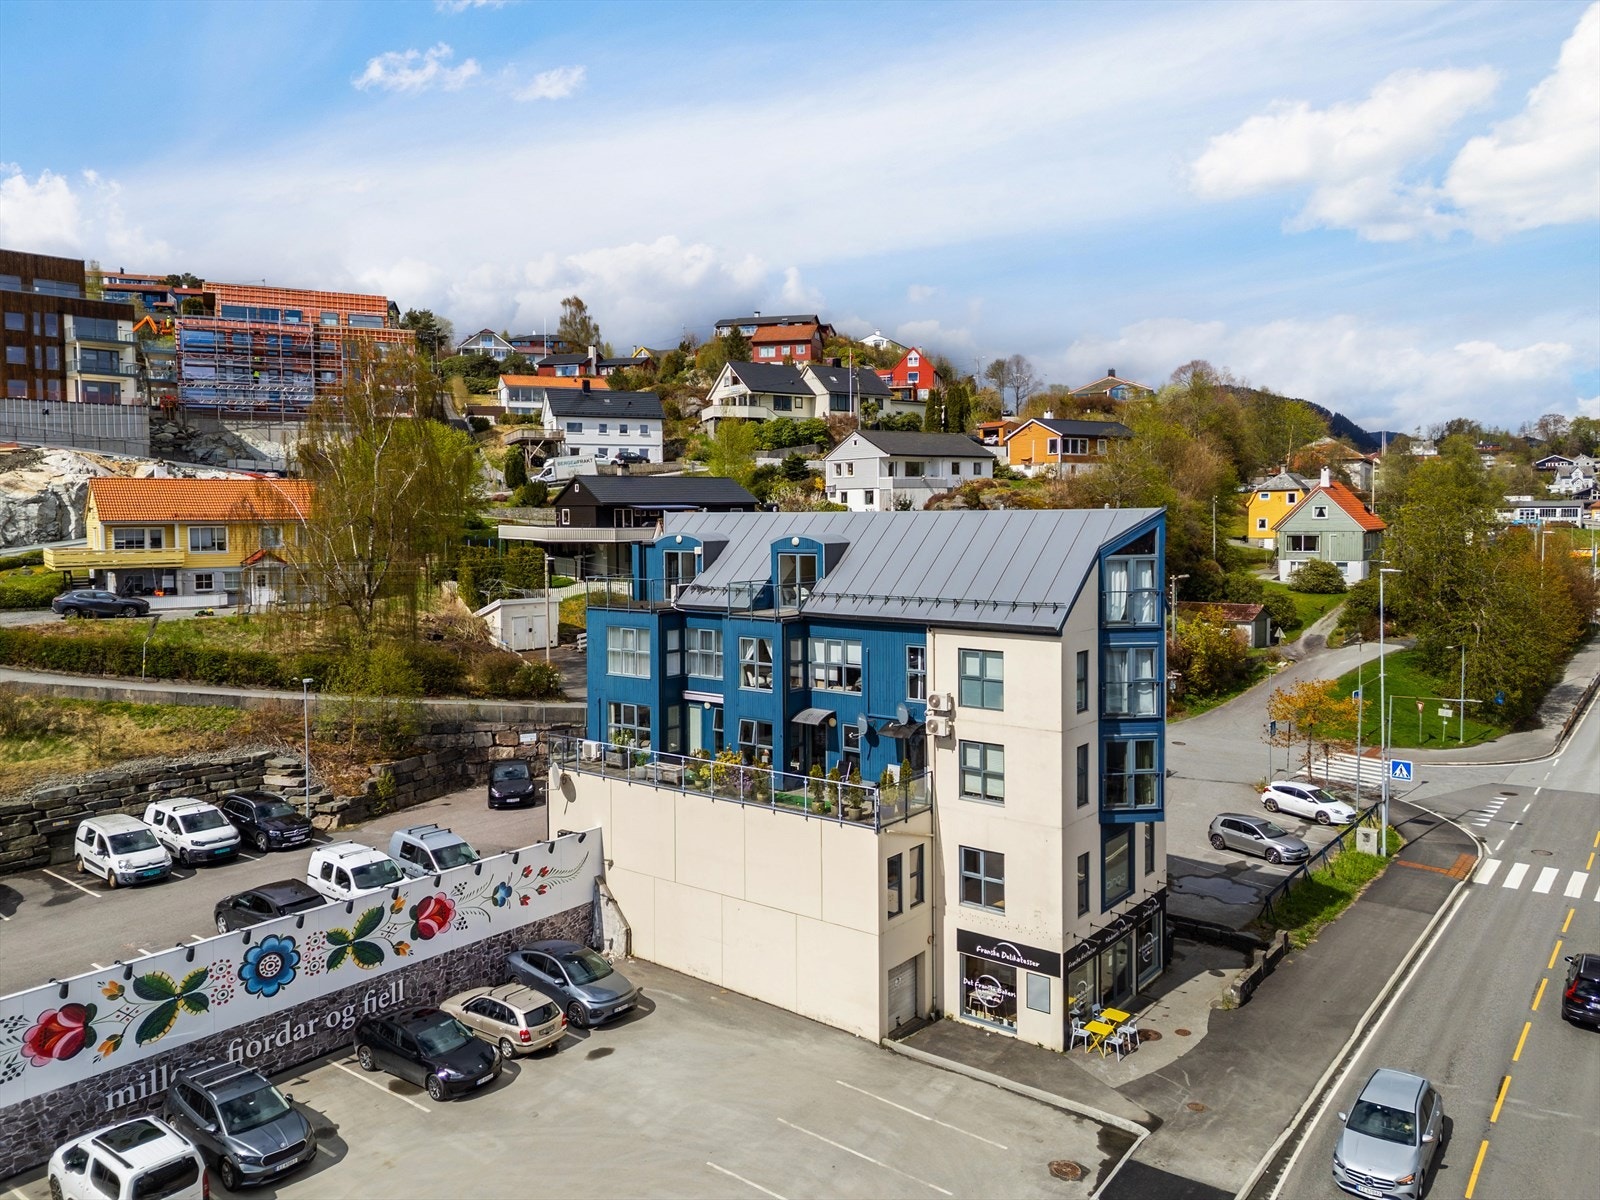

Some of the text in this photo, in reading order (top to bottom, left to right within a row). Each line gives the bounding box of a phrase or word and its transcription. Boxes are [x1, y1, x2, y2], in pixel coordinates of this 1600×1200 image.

[976, 945, 1041, 967] Franske Delikatesser
[326, 1003, 356, 1030] og
[364, 980, 405, 1014] fjell
